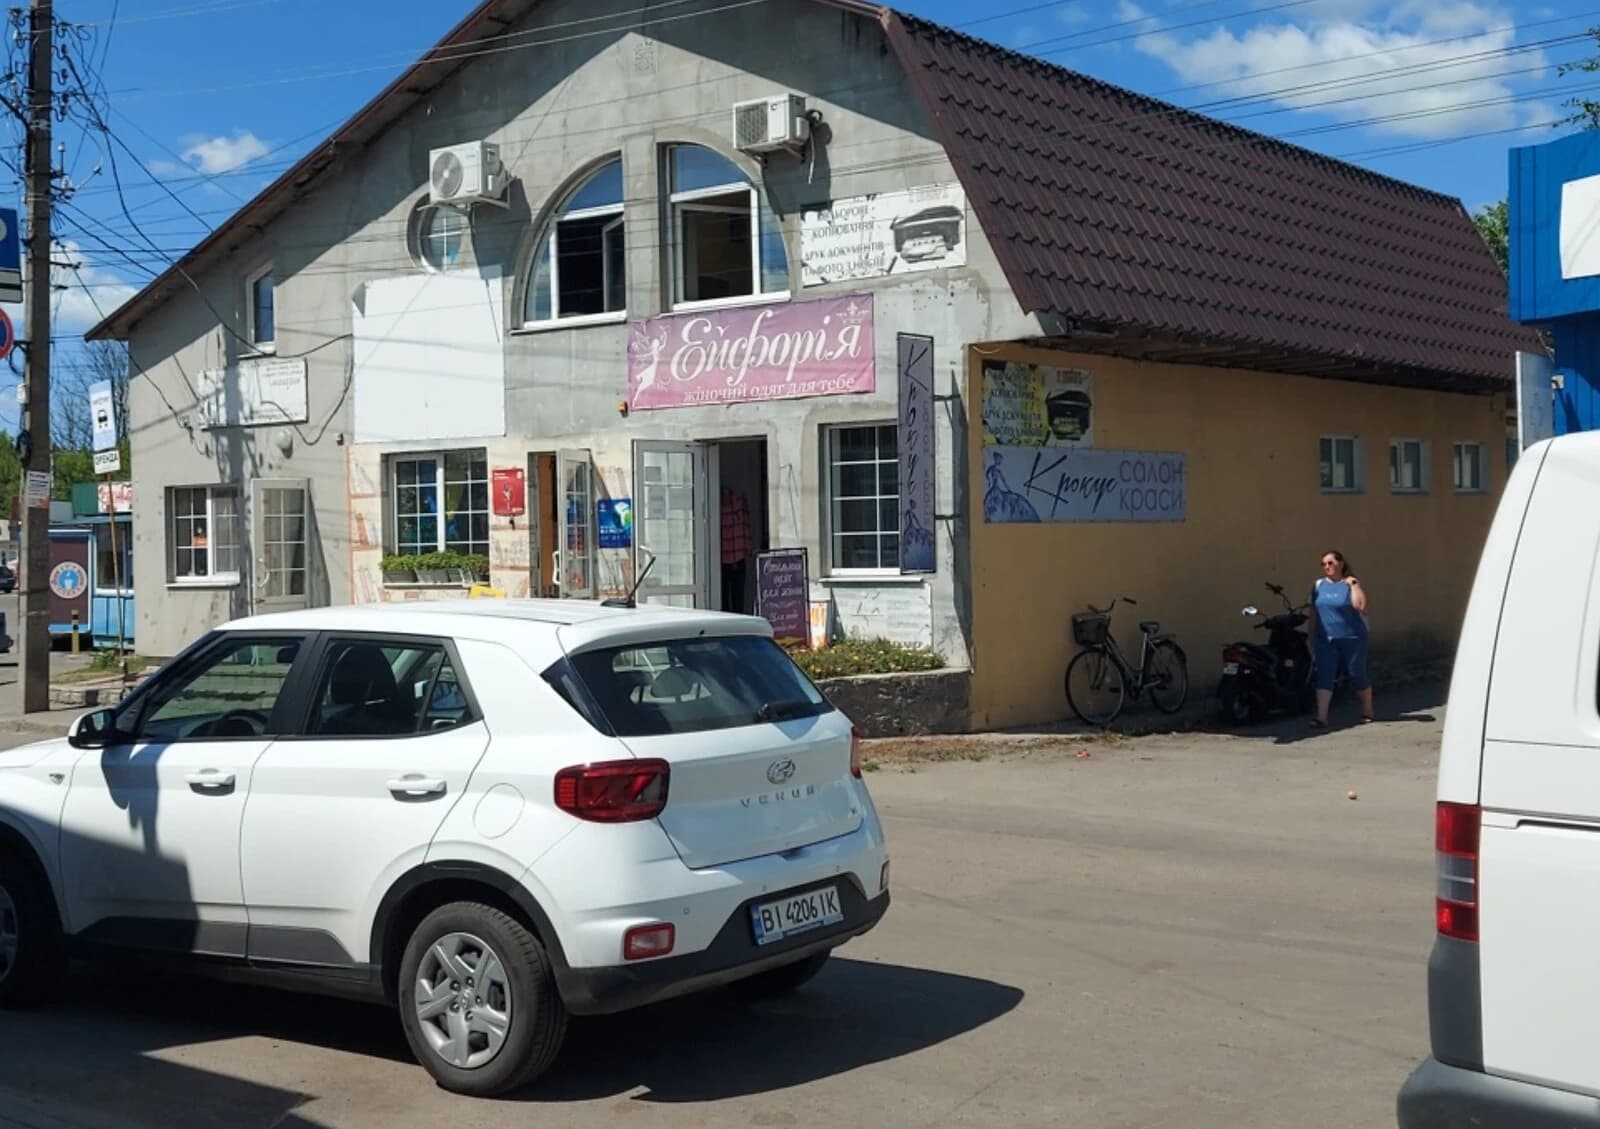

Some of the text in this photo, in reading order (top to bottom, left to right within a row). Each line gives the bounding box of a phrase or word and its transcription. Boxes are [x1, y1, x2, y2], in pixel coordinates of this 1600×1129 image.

[671, 310, 861, 386] Ейфорія
[684, 374, 855, 402] жіночий одяг для тебе
[1024, 452, 1118, 520] Крокус
[762, 891, 838, 933] BI 4206 IK
